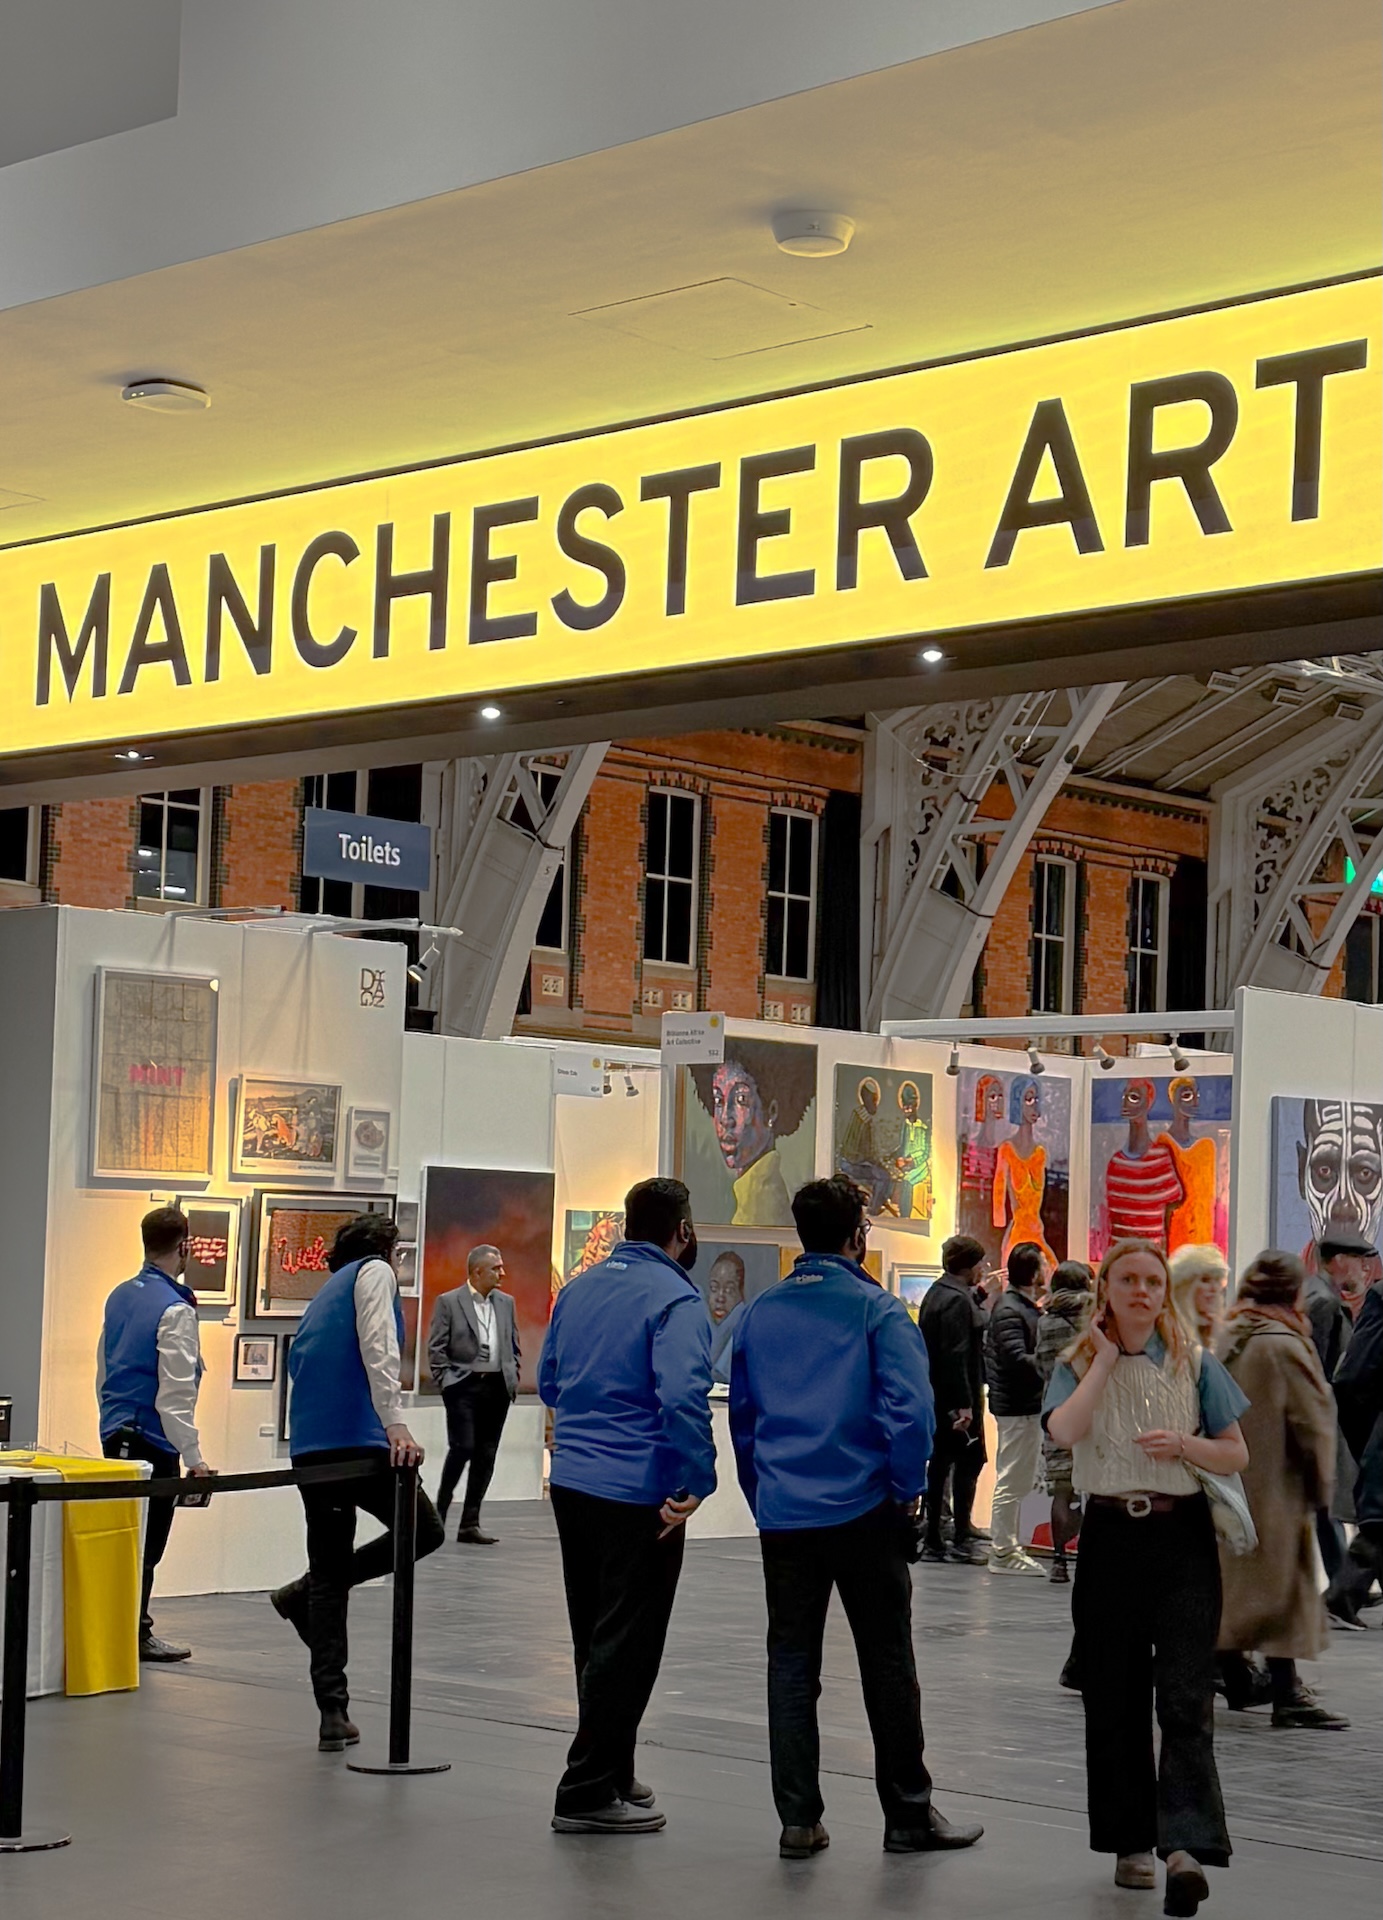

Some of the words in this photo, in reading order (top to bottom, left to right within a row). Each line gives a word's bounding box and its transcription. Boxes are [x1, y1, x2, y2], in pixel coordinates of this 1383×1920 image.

[36, 427, 933, 705] MANCHESTER
[984, 338, 1368, 569] ART
[338, 832, 401, 867] Toilets
